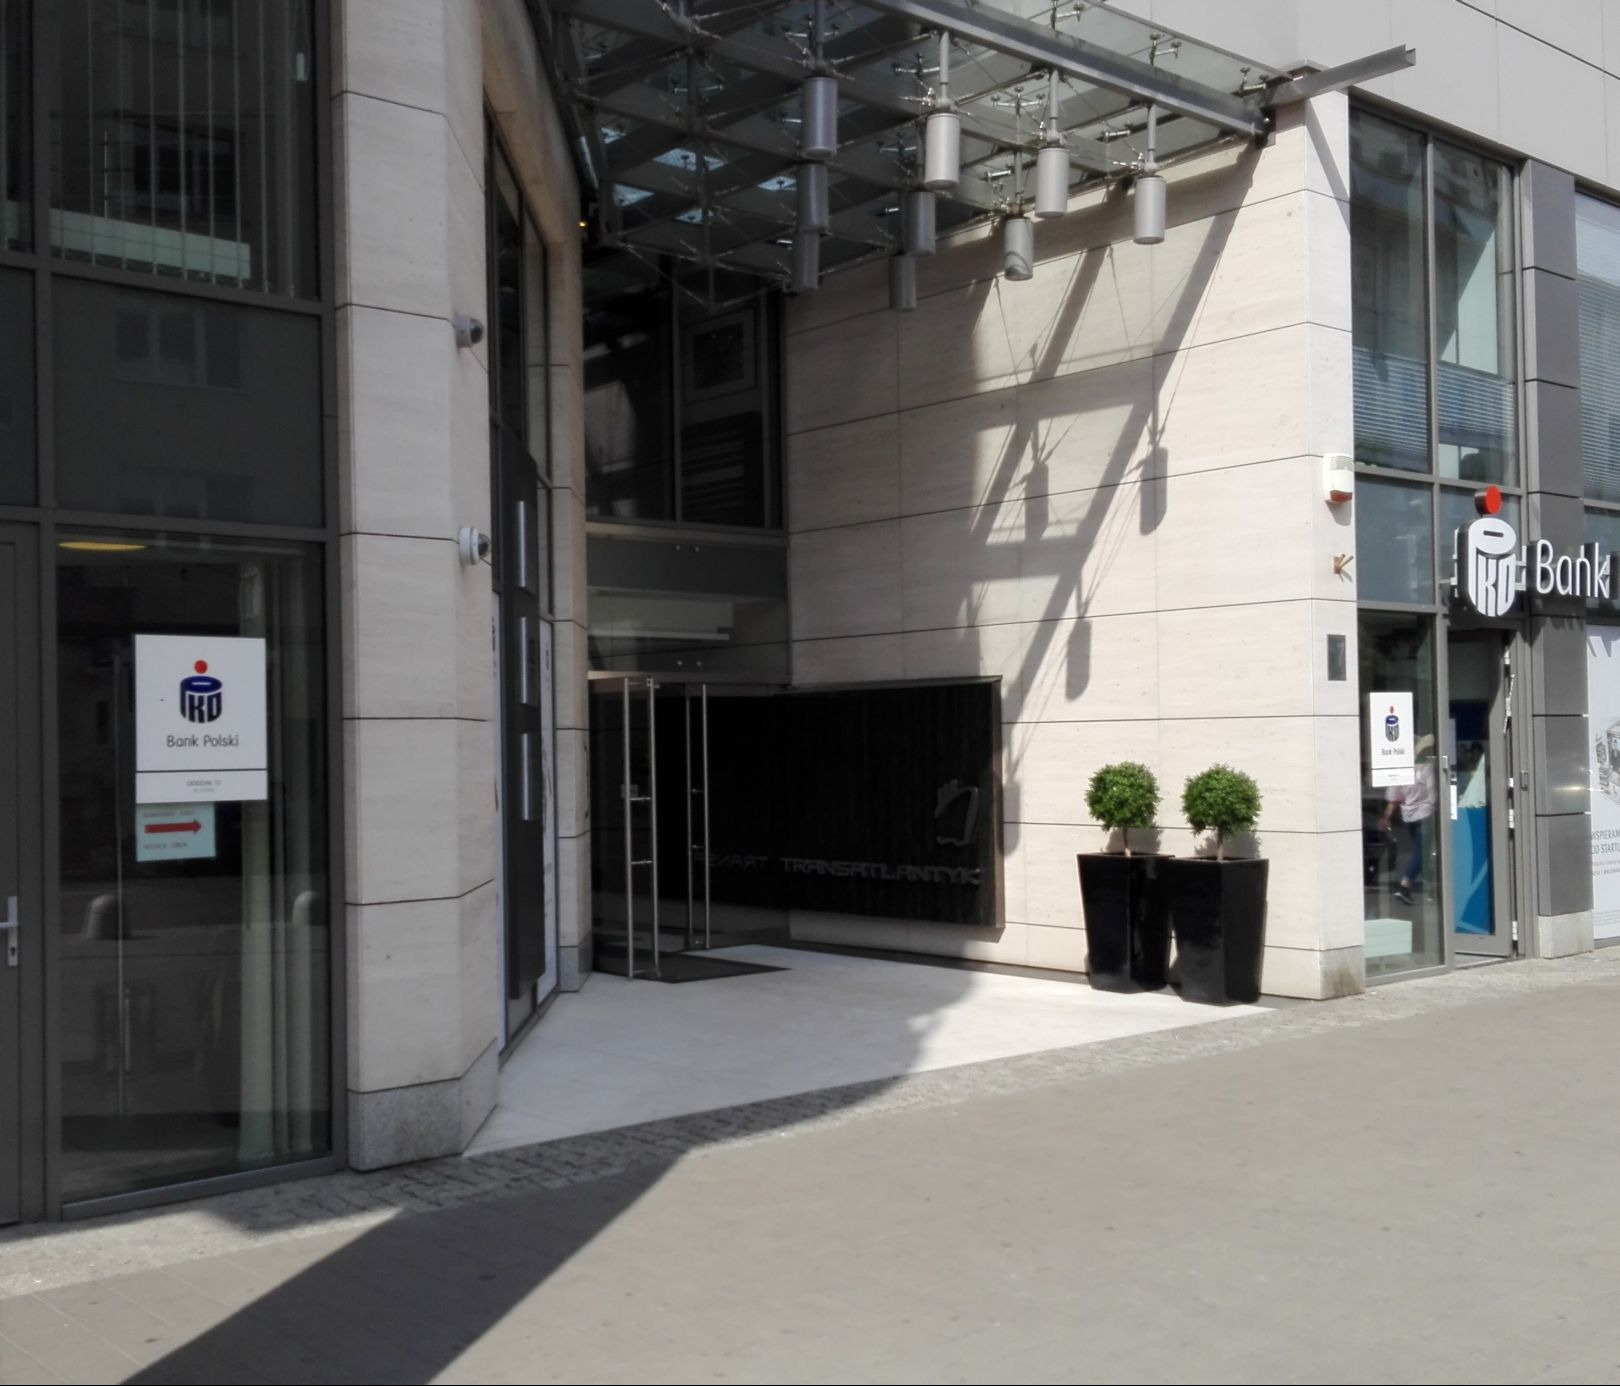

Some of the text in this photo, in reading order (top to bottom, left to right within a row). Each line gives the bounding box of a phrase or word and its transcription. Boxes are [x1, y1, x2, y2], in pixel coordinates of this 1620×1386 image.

[1536, 539, 1611, 599] Bank
[166, 734, 240, 748] Bank Polski
[780, 857, 982, 885] TRANSATLANTYK
